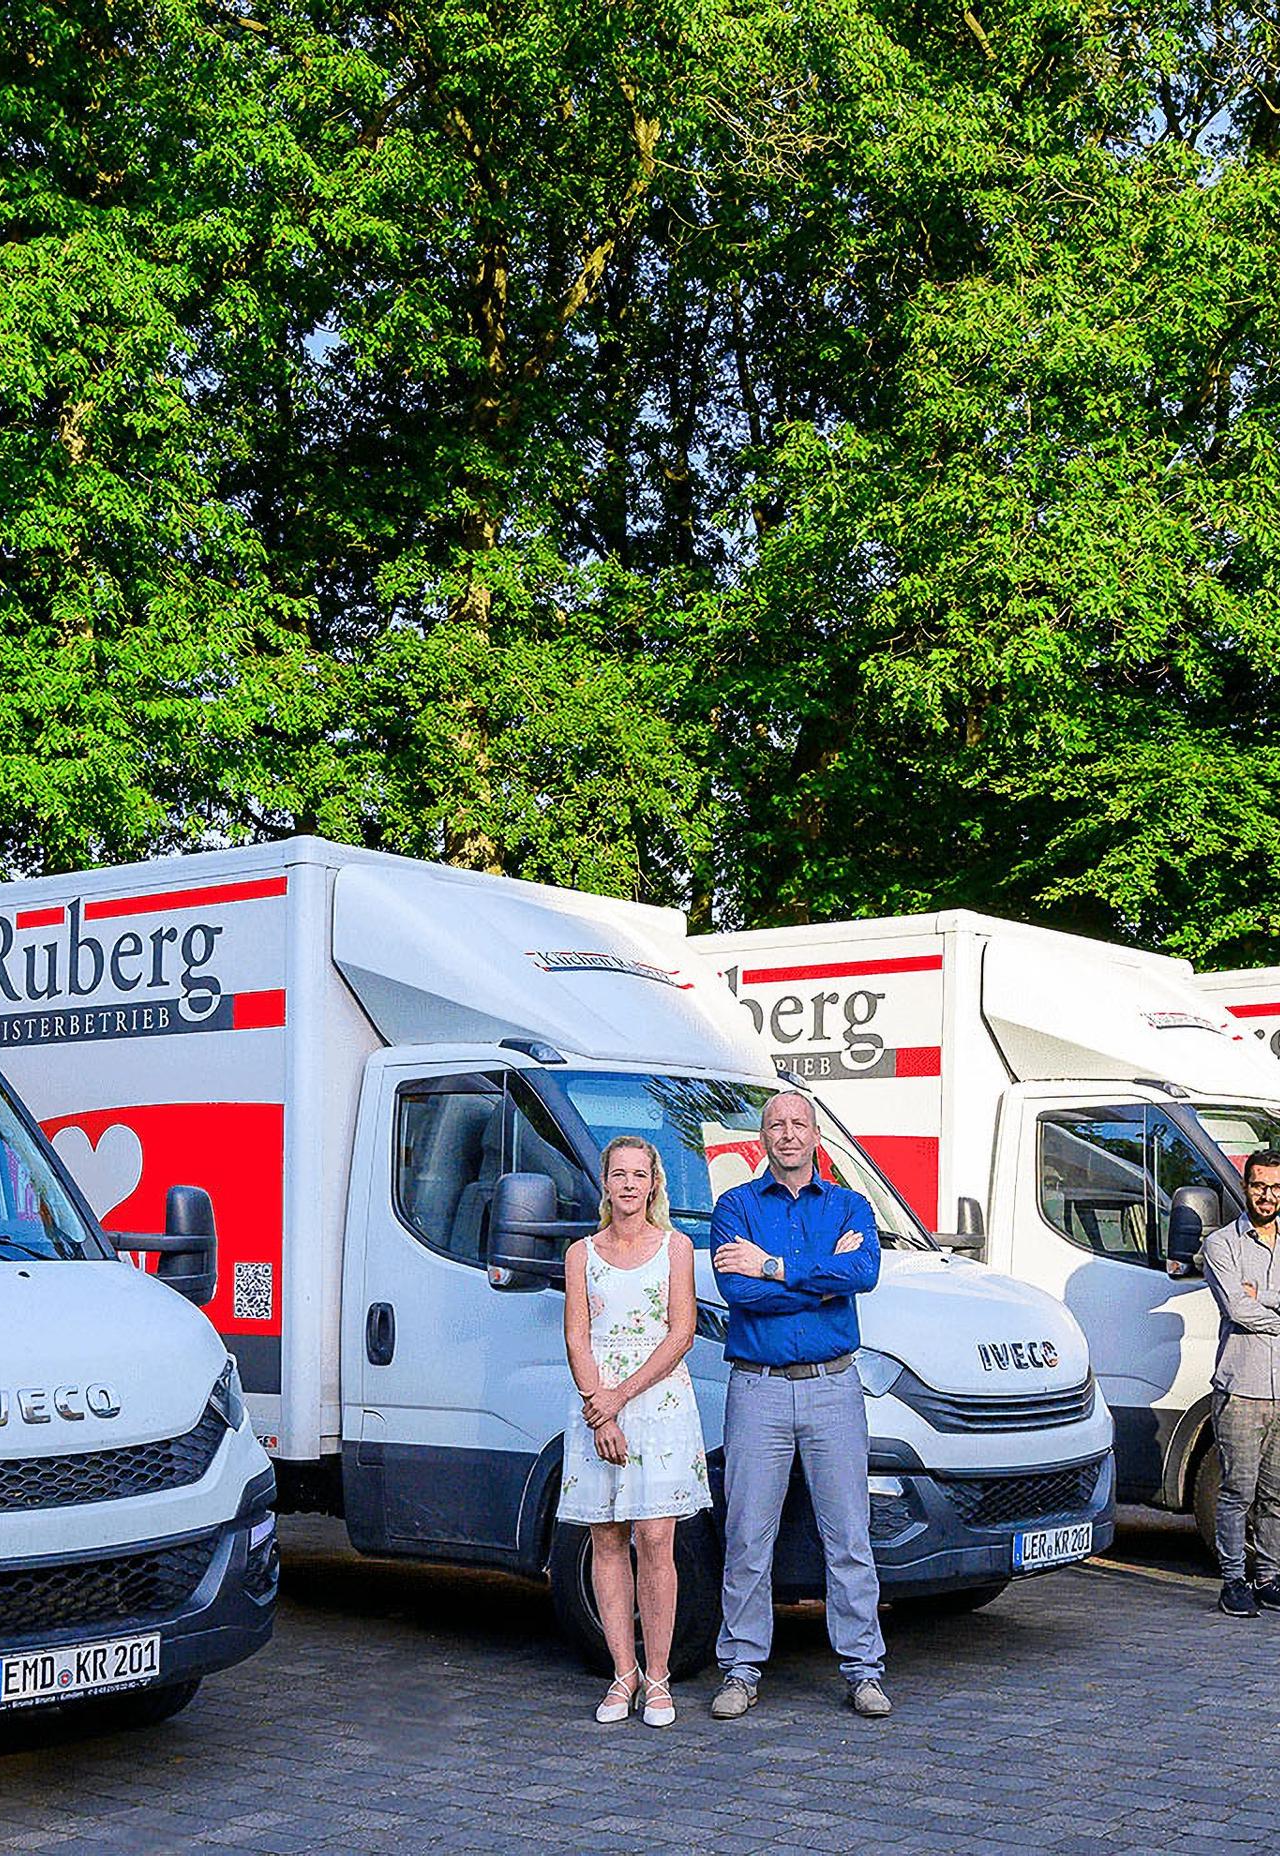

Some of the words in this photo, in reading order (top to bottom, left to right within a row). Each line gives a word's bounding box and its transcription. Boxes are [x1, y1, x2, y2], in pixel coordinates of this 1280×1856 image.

[977, 1341, 1058, 1371] IVECO
[1023, 1533, 1047, 1561] LER
[1054, 1530, 1070, 1556] KR
[1071, 1526, 1090, 1552] 201
[4, 1656, 55, 1695] EMD
[76, 1649, 107, 1684] KR
[113, 1640, 157, 1677] 201
